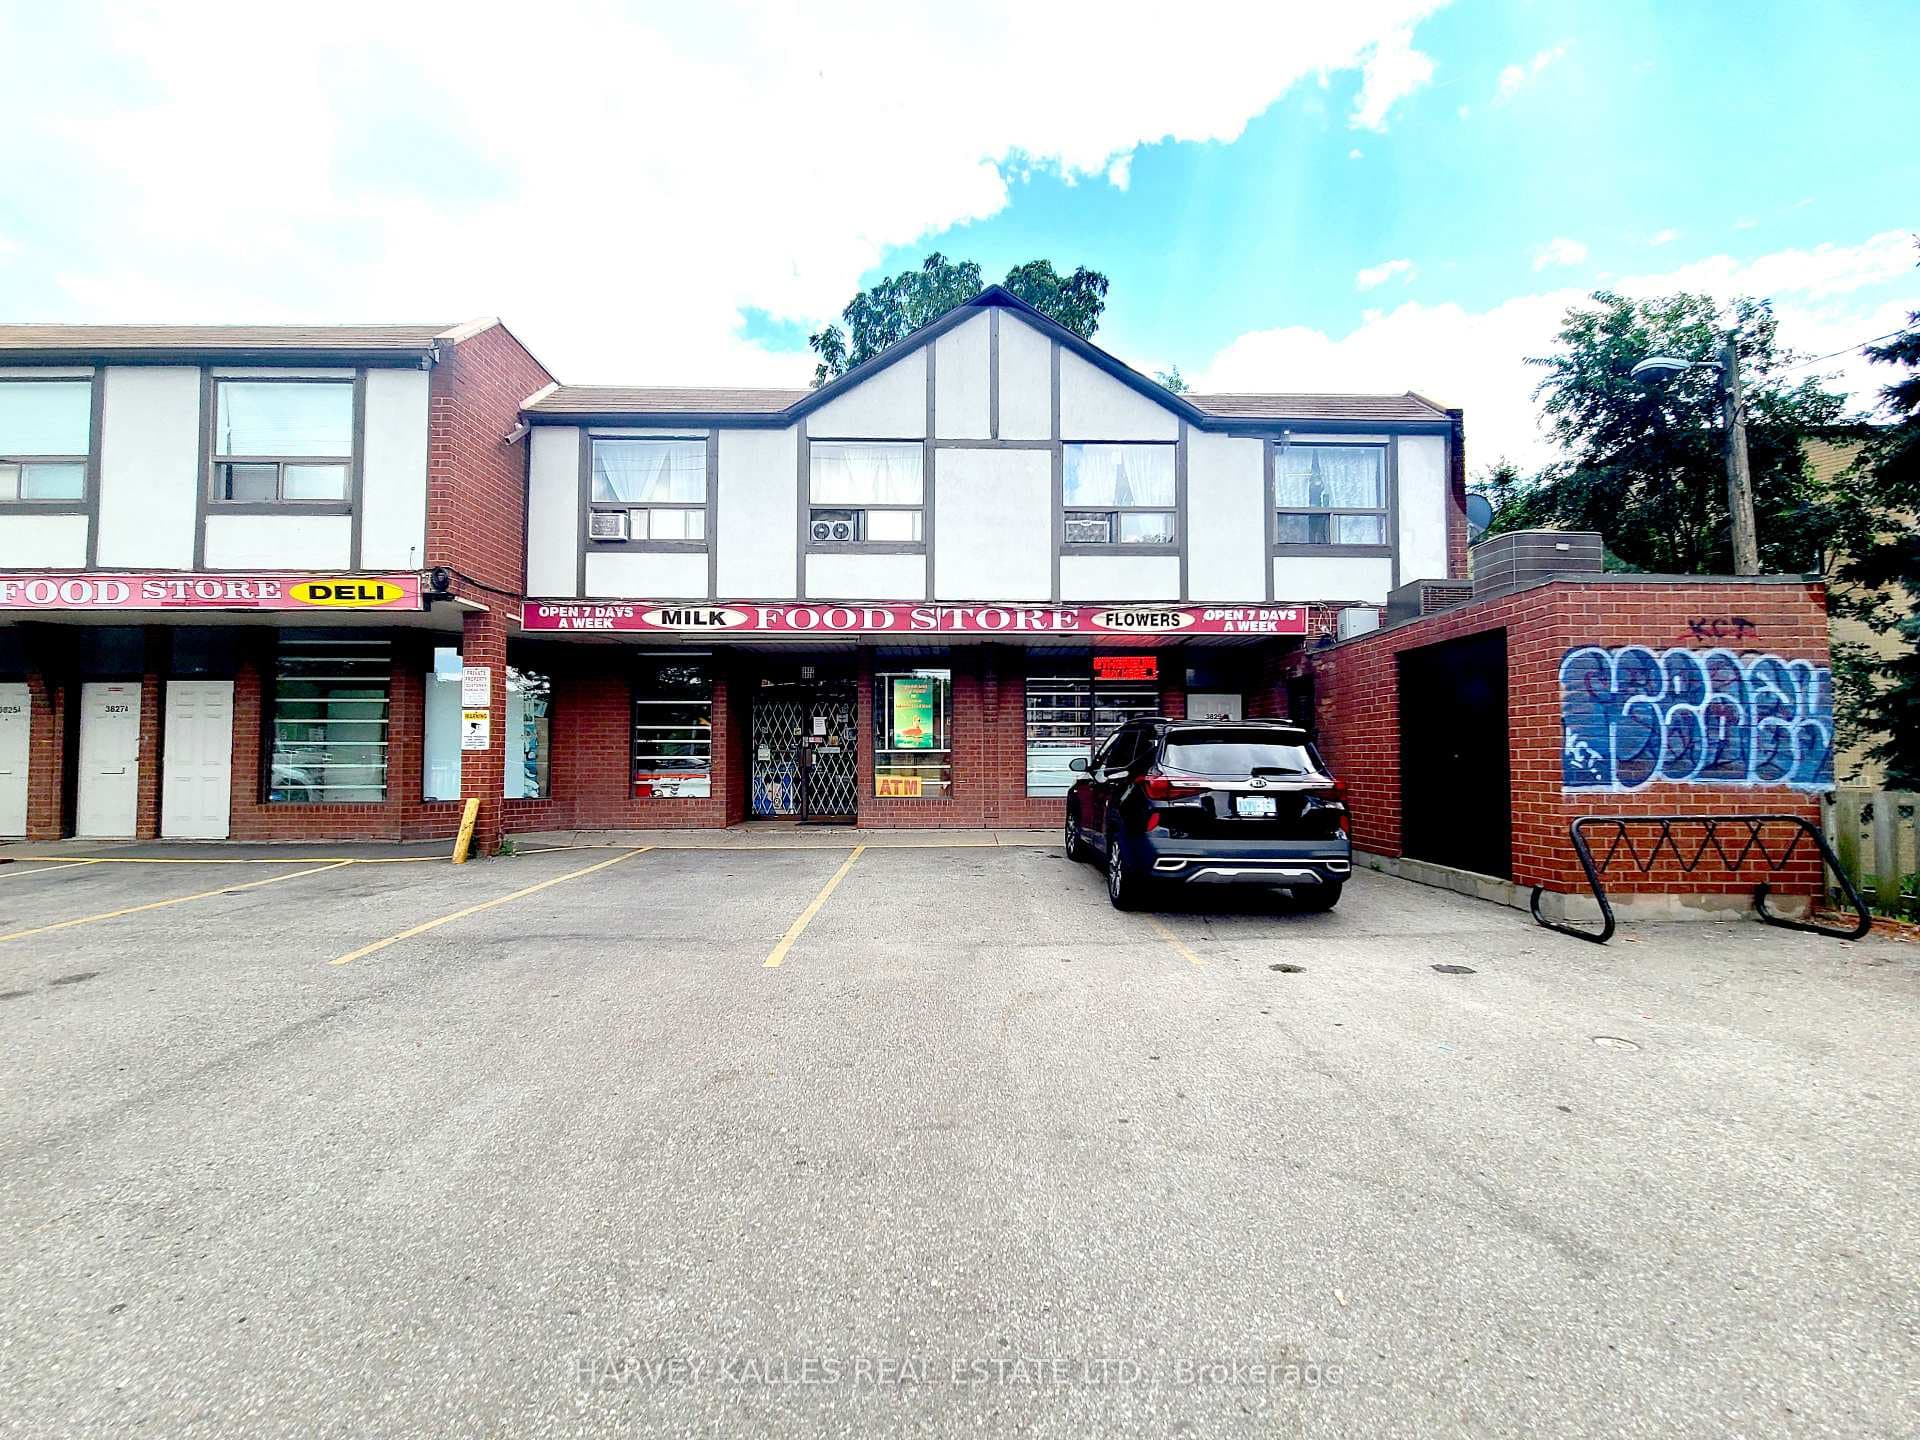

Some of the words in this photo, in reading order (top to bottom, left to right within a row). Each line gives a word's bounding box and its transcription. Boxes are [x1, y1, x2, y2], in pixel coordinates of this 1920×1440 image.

[0, 579, 130, 604] FOOD
[142, 580, 282, 599] STORE
[309, 586, 384, 599] DELI
[538, 607, 579, 618] OPEN
[583, 607, 591, 617] 7
[595, 607, 633, 618] DAYS
[661, 610, 727, 626] MILK
[754, 608, 895, 629] FOOD
[910, 608, 1079, 630] STORE
[1203, 610, 1244, 621] OPEN
[1247, 610, 1256, 620] 7
[1260, 610, 1296, 621] DAYS
[558, 618, 569, 629] A
[572, 618, 614, 629] WEEK
[1106, 613, 1181, 627] FLOWERS
[1223, 620, 1234, 632] A
[1237, 620, 1278, 632] WEEK
[879, 779, 918, 796] ATM
